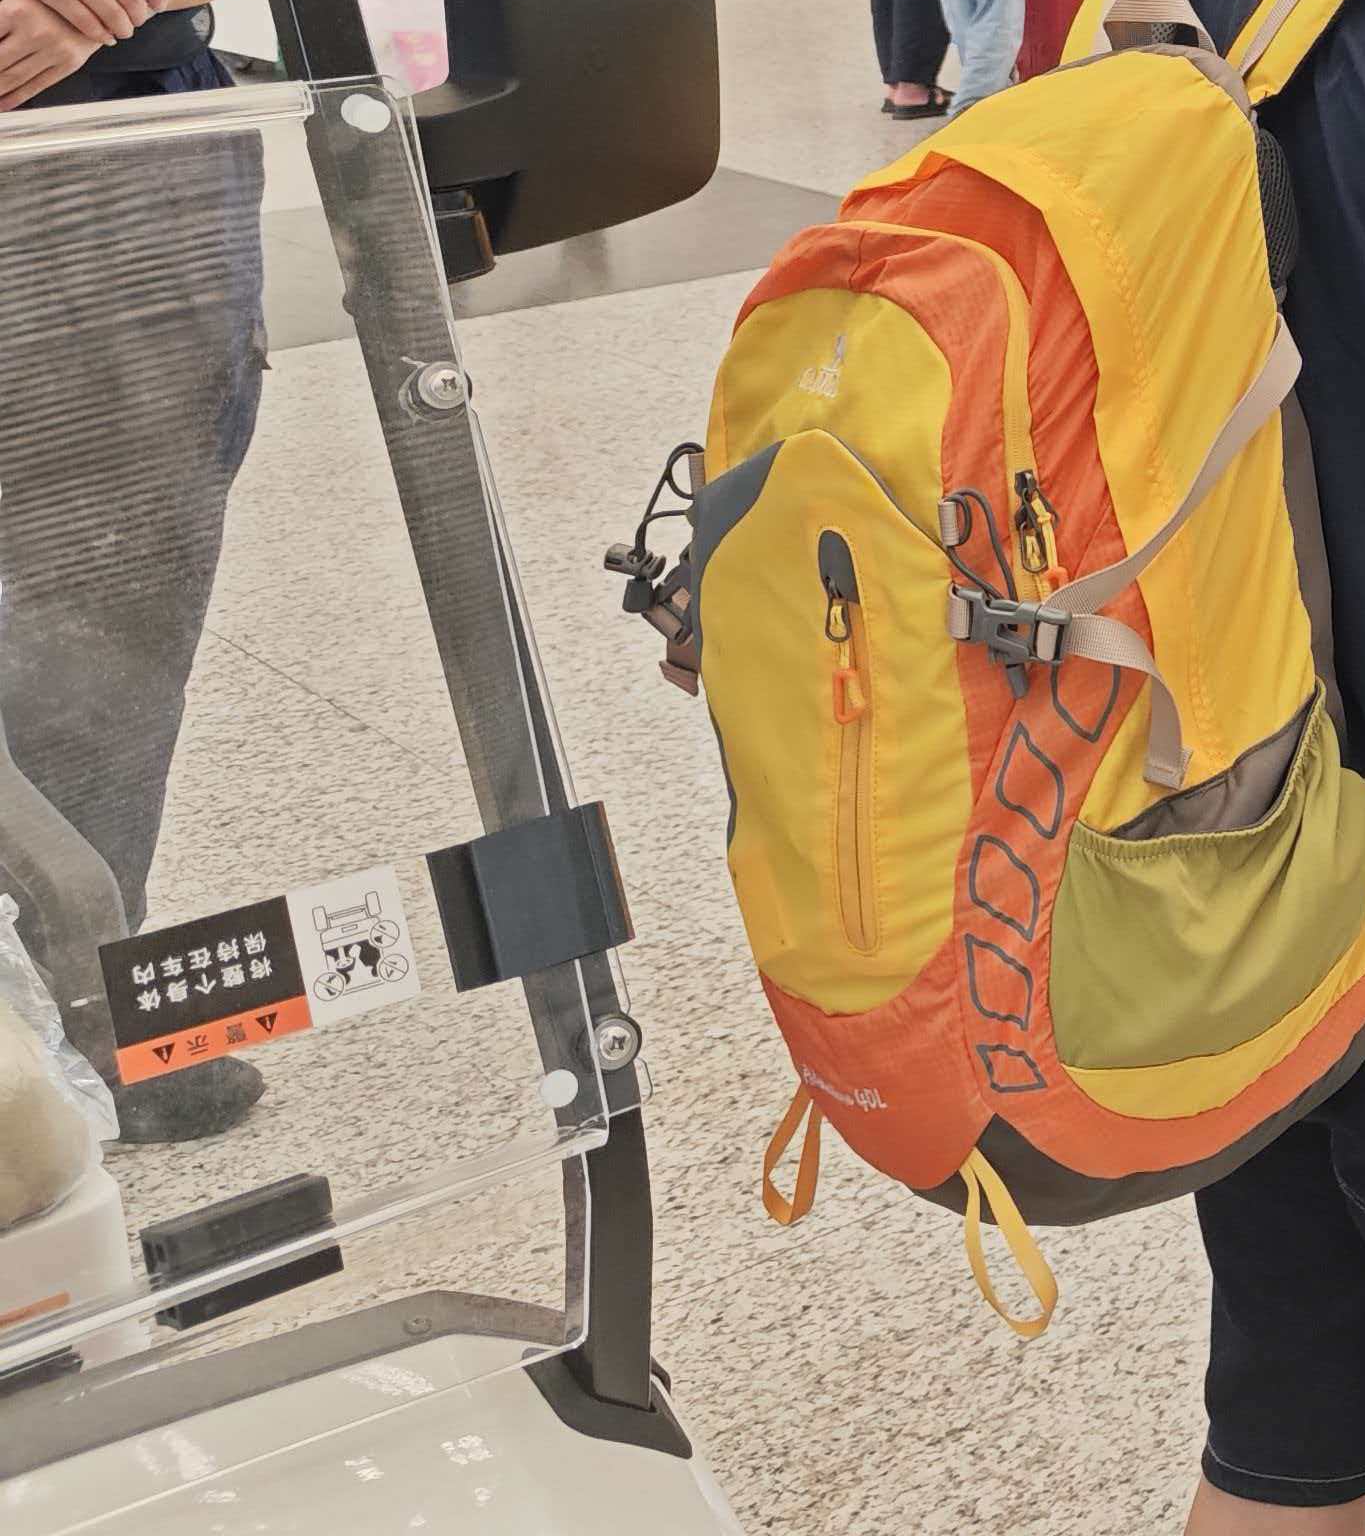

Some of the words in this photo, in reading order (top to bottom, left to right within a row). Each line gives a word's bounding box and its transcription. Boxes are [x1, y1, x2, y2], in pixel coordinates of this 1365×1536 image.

[131, 929, 268, 988] 保持在车内
[134, 955, 274, 1014] 将整个身体
[853, 1087, 888, 1113] 40L
